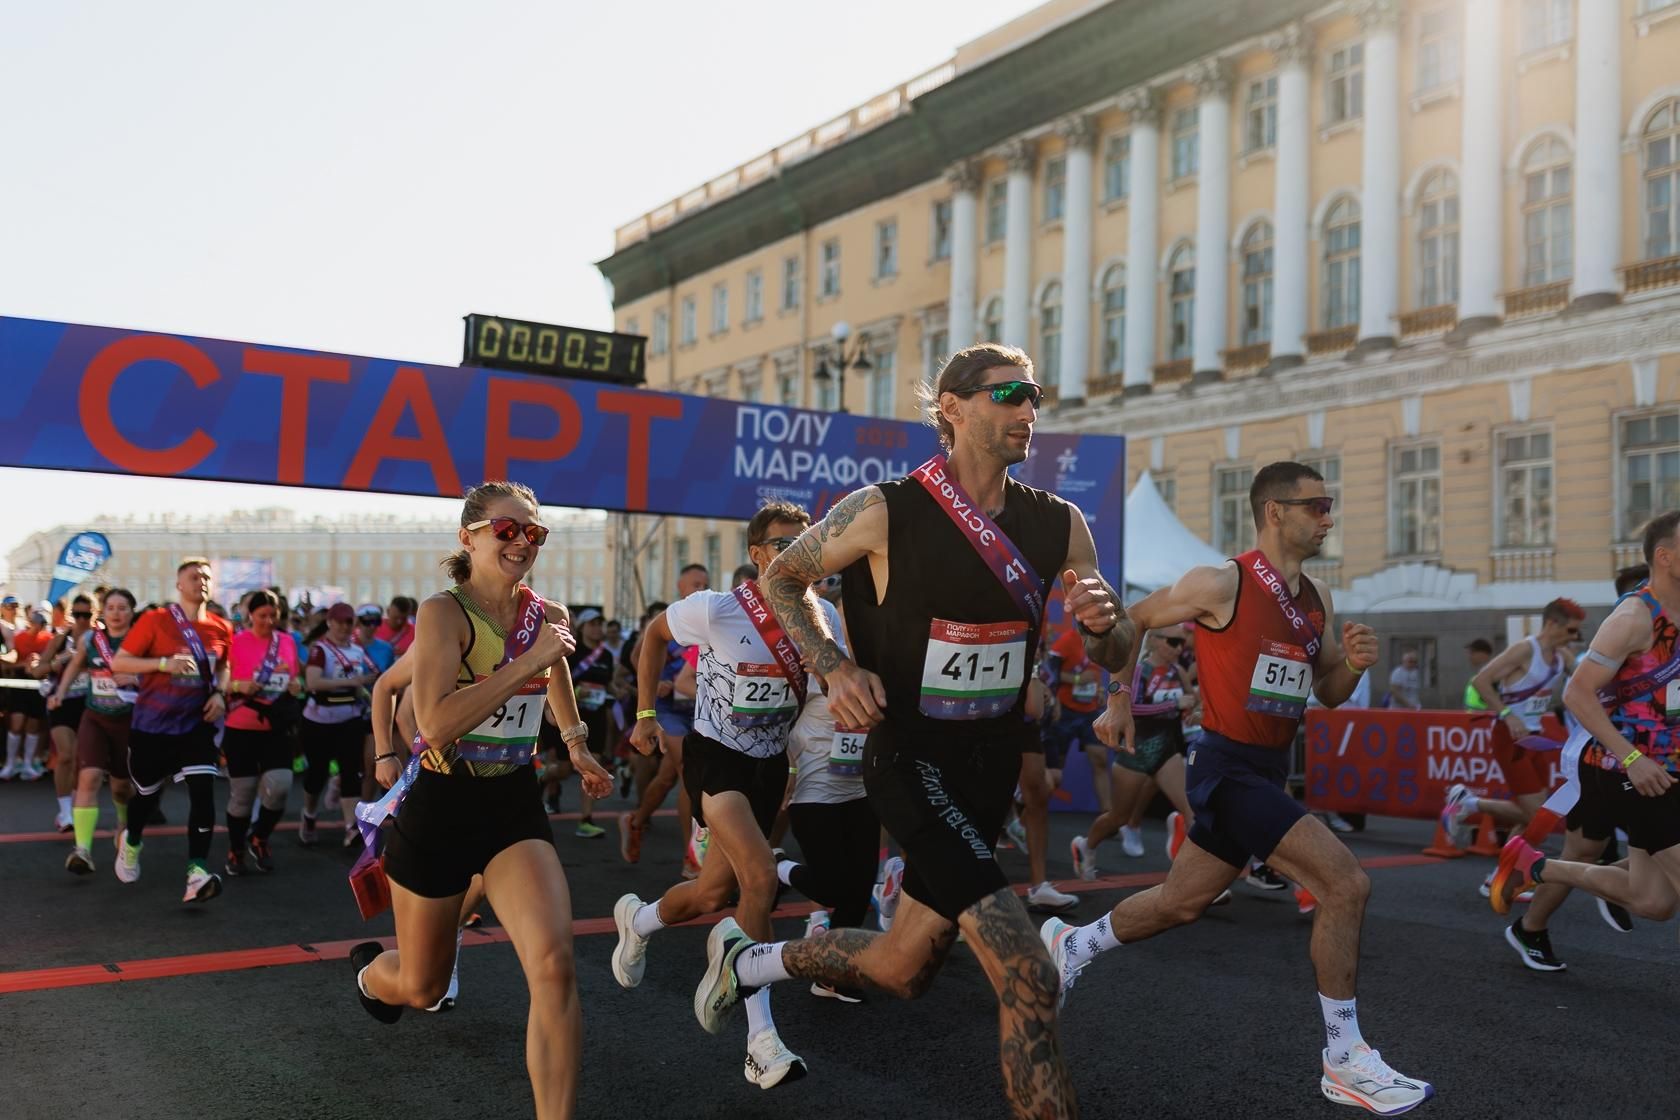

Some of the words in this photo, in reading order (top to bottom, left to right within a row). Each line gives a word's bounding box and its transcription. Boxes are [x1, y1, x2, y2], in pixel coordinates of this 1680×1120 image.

[78, 333, 684, 512] СТАРТ
[736, 406, 832, 447] ПОЛУ
[734, 445, 908, 486] МАРАФОН
[1005, 558, 1027, 583] 41
[1253, 558, 1304, 630] ЭСТАФЕТА
[946, 630, 980, 639] МАРАФОН
[1305, 637, 1321, 656] 51
[941, 652, 1010, 680] 41-1
[1265, 662, 1307, 690] 51-1
[745, 682, 790, 701] 22-1
[1312, 721, 1418, 760] 3/08
[1311, 764, 1421, 806] 2025
